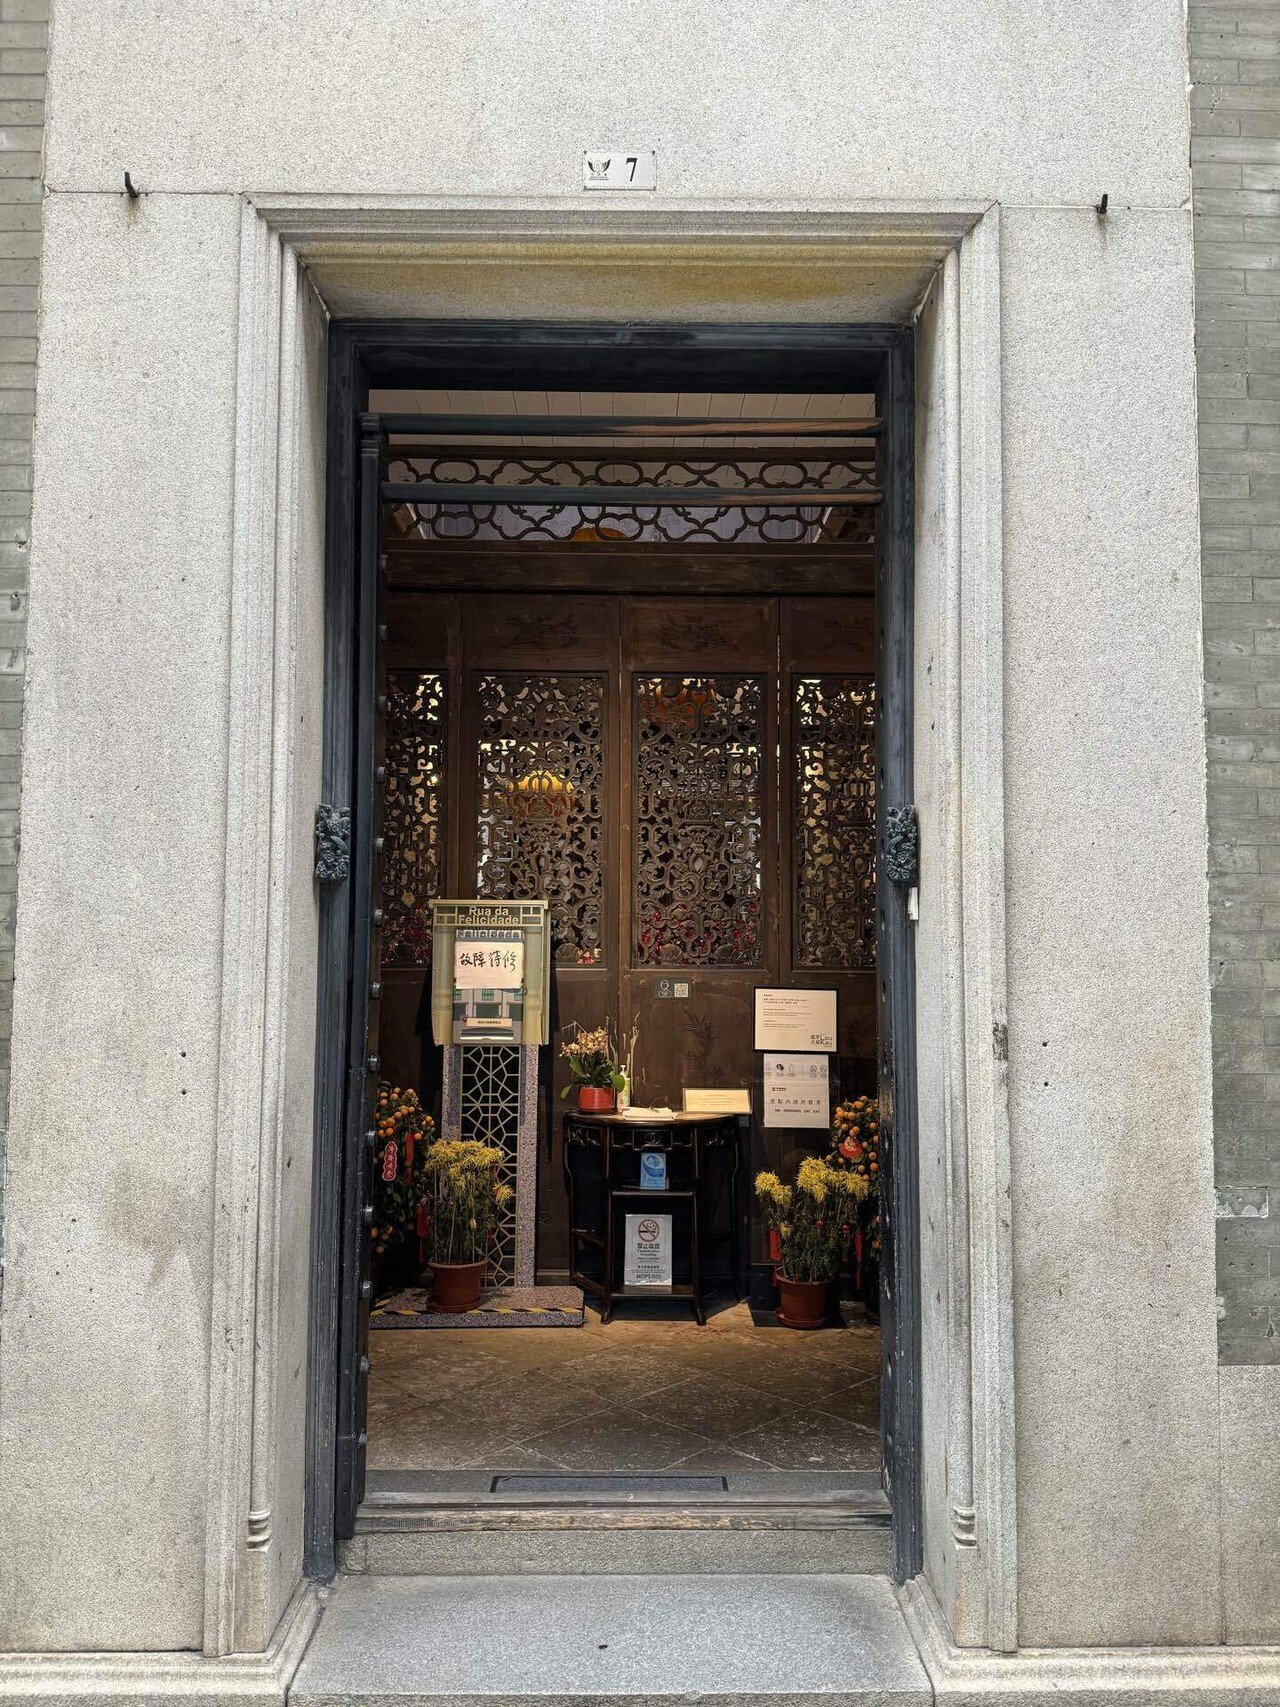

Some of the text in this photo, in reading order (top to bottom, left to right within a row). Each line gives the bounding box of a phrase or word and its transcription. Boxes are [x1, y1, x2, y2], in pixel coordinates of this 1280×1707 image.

[626, 157, 638, 182] 7
[469, 905, 509, 915] Rua da
[458, 915, 519, 924] Felicidade
